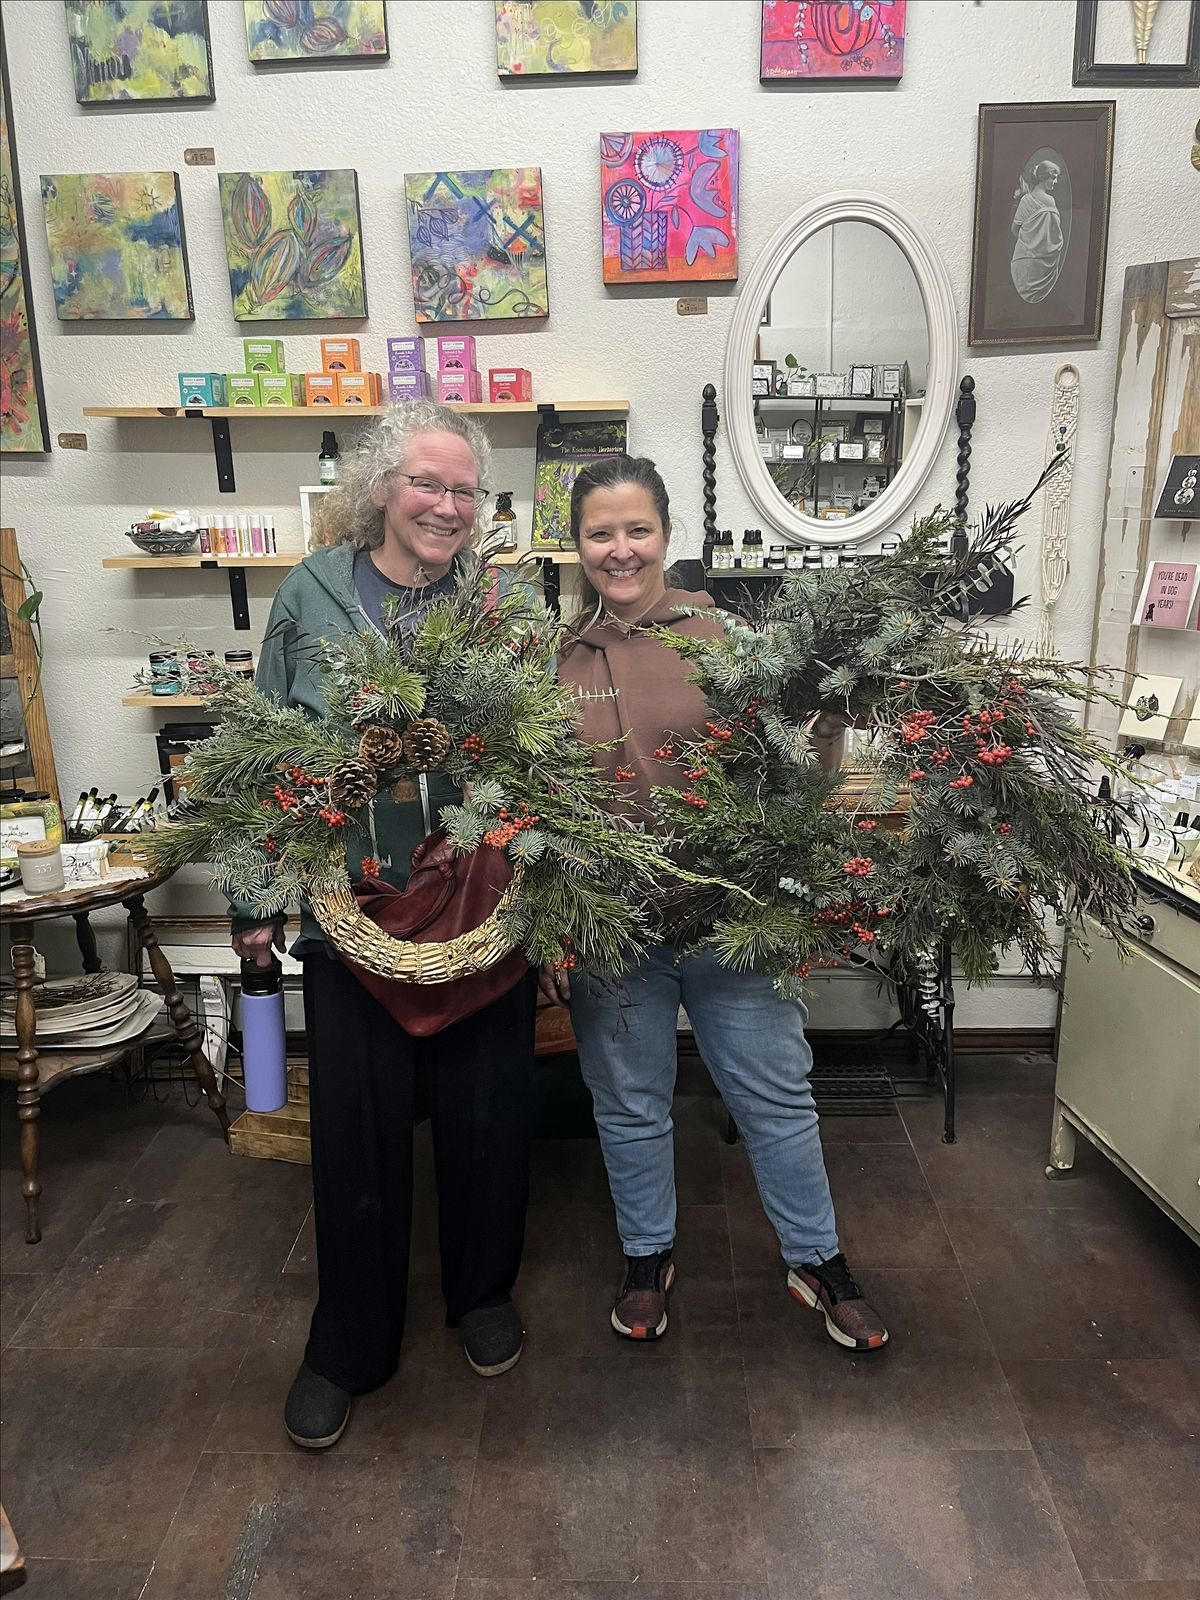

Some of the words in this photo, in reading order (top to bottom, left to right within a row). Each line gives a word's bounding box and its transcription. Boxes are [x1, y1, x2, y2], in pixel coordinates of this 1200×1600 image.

[1158, 571, 1174, 581] YOU'RE
[1174, 572, 1188, 582] DEAD
[1160, 585, 1167, 595] IN
[1167, 586, 1178, 595] DOG
[1157, 599, 1174, 609] YEARS!
